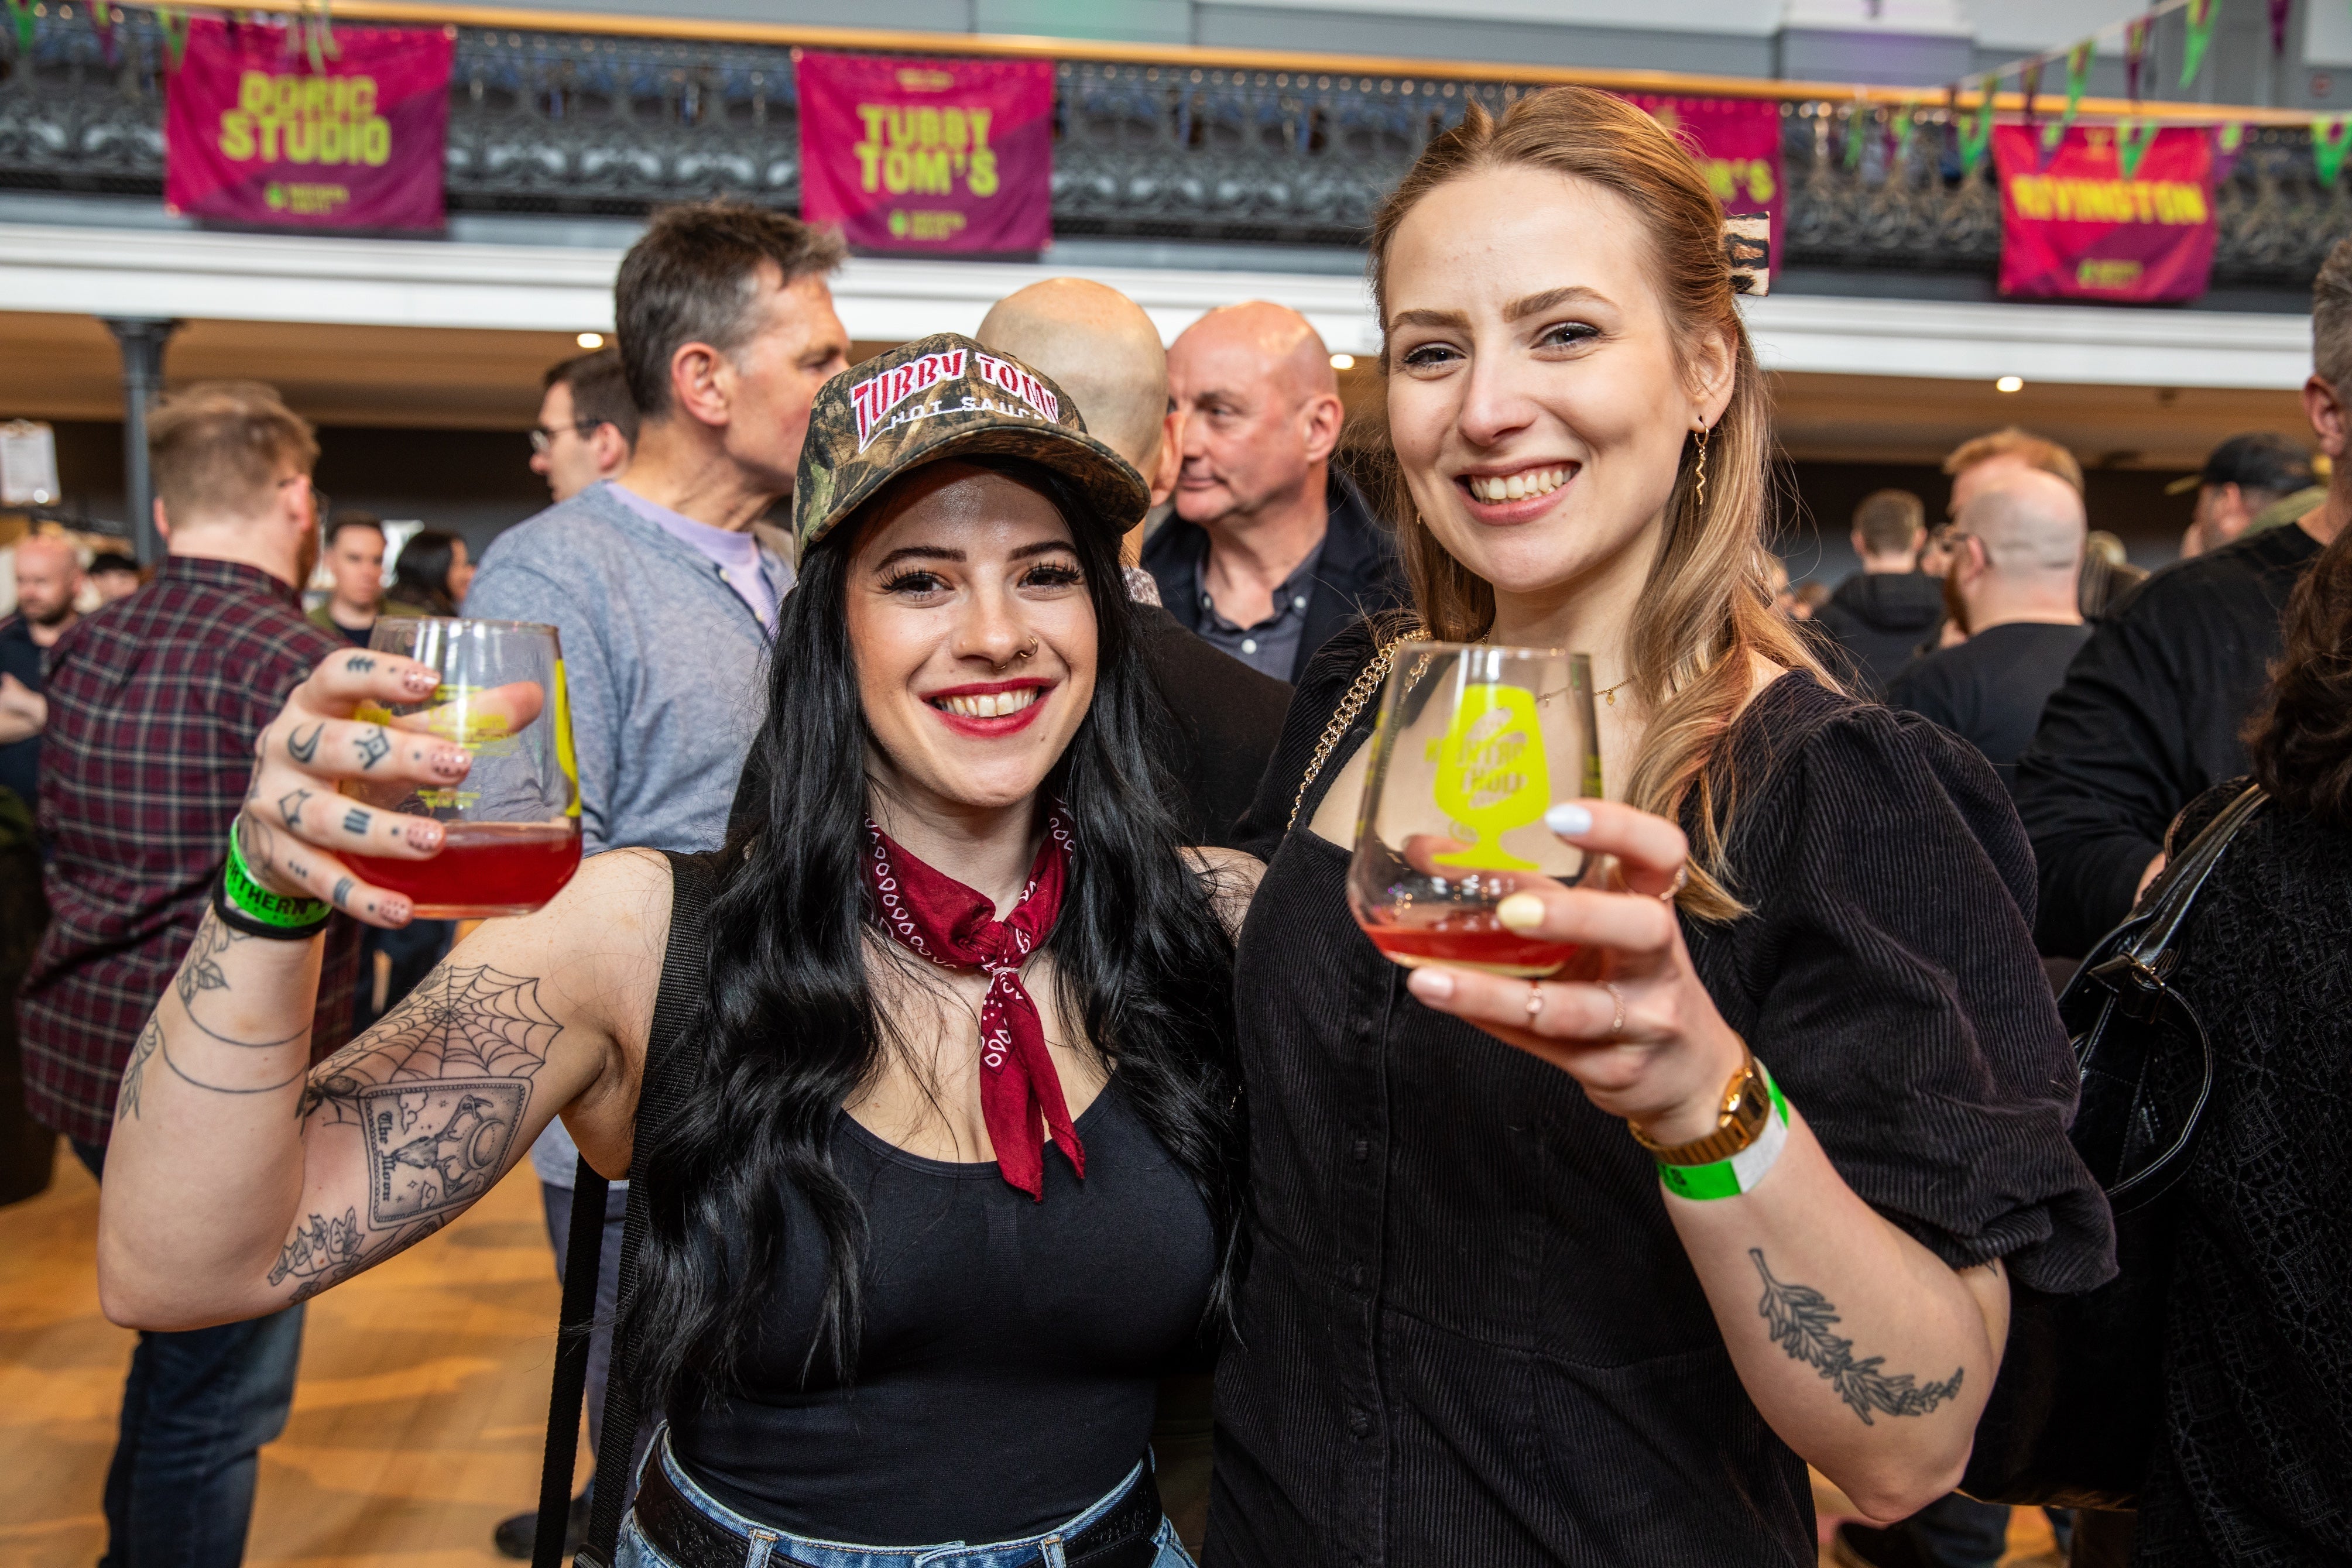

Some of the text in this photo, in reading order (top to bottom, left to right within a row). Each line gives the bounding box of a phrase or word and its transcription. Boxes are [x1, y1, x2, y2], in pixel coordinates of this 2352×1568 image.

[219, 110, 390, 166] STUDIO
[856, 103, 992, 149] TUBBY
[853, 142, 1000, 197] TOM'S
[850, 349, 968, 454] TUBBY
[891, 396, 1043, 428] HOT SAUC
[378, 1150, 396, 1202] Moon
